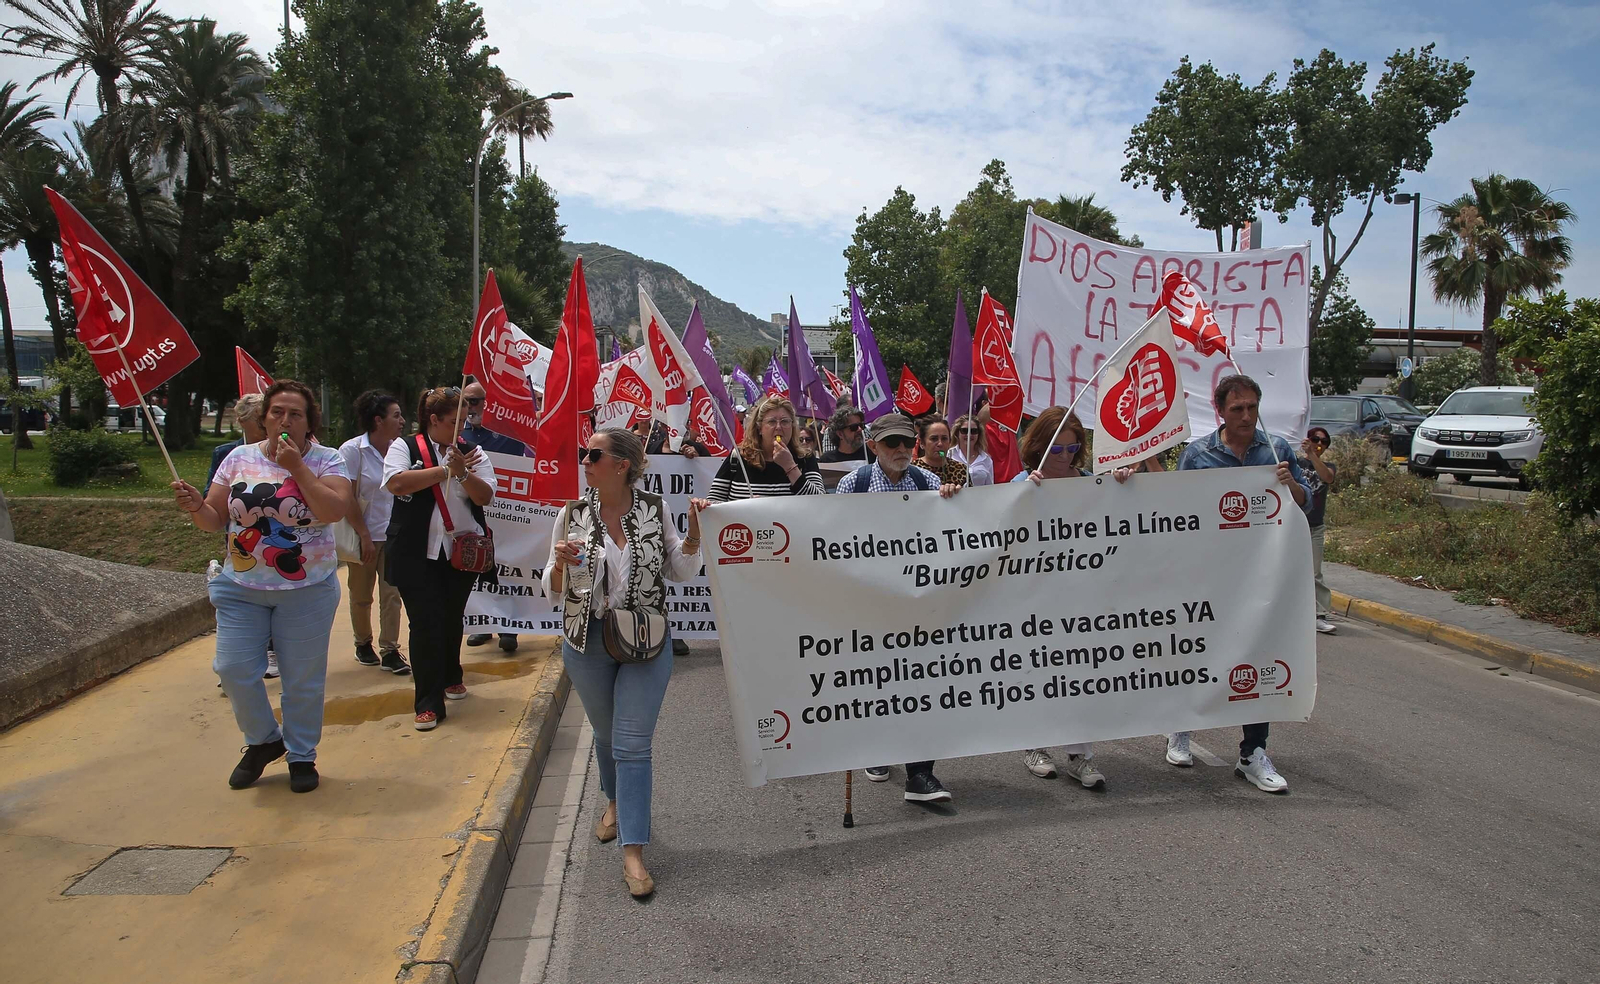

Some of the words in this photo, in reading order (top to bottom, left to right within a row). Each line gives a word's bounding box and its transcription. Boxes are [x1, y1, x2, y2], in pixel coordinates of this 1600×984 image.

[1029, 223, 1118, 290] DIOS
[1085, 291, 1119, 342] LA
[515, 341, 537, 356] UGT
[1139, 350, 1168, 418] UGT
[670, 473, 694, 494] DE
[1222, 495, 1245, 508] UGT
[515, 503, 526, 512] de
[722, 528, 749, 542] UGT
[812, 532, 938, 561] Residencia
[942, 527, 1030, 551] Tiempo
[1037, 517, 1098, 542] Libre
[1104, 515, 1131, 537] La
[1137, 511, 1200, 535] Línea
[902, 562, 990, 588] “Burgo
[997, 545, 1118, 577] Turístico”
[541, 620, 563, 630] DE
[798, 635, 843, 658] Por
[852, 629, 874, 653] la
[882, 622, 1013, 649] cobertura
[1021, 613, 1054, 637] de
[1061, 608, 1177, 633] vacantes
[1182, 600, 1215, 623] YA
[810, 671, 825, 697] y
[833, 652, 982, 689] ampliación
[990, 648, 1022, 671] de
[1030, 645, 1124, 669] tiempo
[1132, 641, 1162, 659] en
[1170, 633, 1206, 655] los
[1232, 668, 1255, 681] UGT
[802, 694, 931, 724] contratos
[939, 685, 972, 709] de
[979, 680, 1035, 711] fijos
[1043, 667, 1218, 698] discontinuos.
